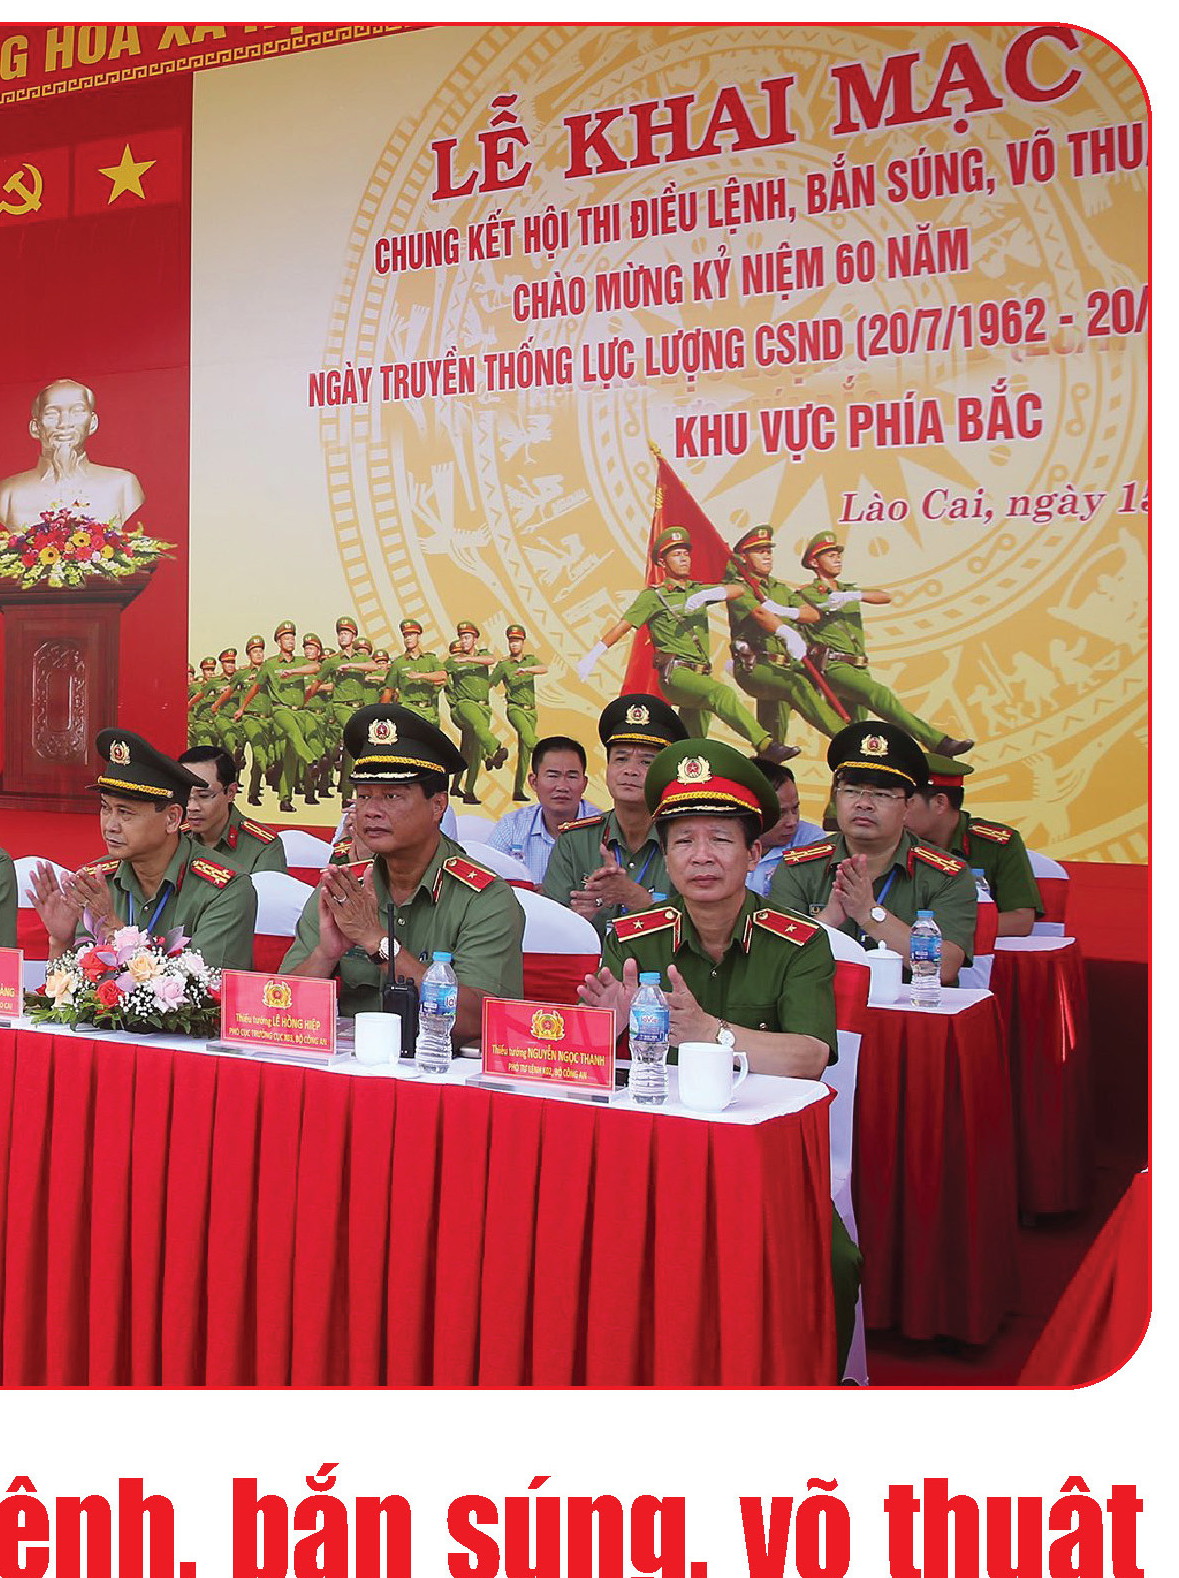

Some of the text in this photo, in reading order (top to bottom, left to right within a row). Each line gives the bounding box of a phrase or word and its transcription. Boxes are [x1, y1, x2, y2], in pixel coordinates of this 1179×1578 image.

[431, 26, 1083, 201] LỄ KHAI MẠC
[375, 122, 1148, 275] CHUNG KẾT HỘI THI ĐIỀU LỆNH, BẮN SÚNG, VÕ THU
[514, 223, 970, 322] CHÀO MỪNG KỶ NIỆM 60 NĂM
[308, 361, 373, 408] NGÀY
[379, 345, 475, 401] TRUYỀN
[484, 336, 573, 393] THỐNG
[583, 336, 635, 390] LỰC
[645, 318, 745, 392] LƯỢNG
[755, 318, 843, 367] CSND
[857, 297, 1046, 362] (20/7/1962
[1059, 314, 1074, 326] -
[674, 412, 748, 458] KHU
[760, 402, 836, 461] VỰC
[849, 390, 943, 450] PHÍA
[958, 378, 1043, 443] BẮC
[839, 482, 908, 524] Lào
[921, 487, 993, 525] Cai,
[1006, 483, 1107, 523] ngày
[236, 1013, 321, 1033] Thiếu tướng LÊ HỒNG HIỆP
[319, 1038, 328, 1046] AN
[492, 1044, 508, 1055] Thiếu
[509, 1046, 527, 1060] tướng
[527, 1044, 556, 1061] NGUYỄN
[558, 1050, 578, 1066] NGỌC
[563, 1067, 578, 1078] CÔNG
[579, 1071, 588, 1080] AN
